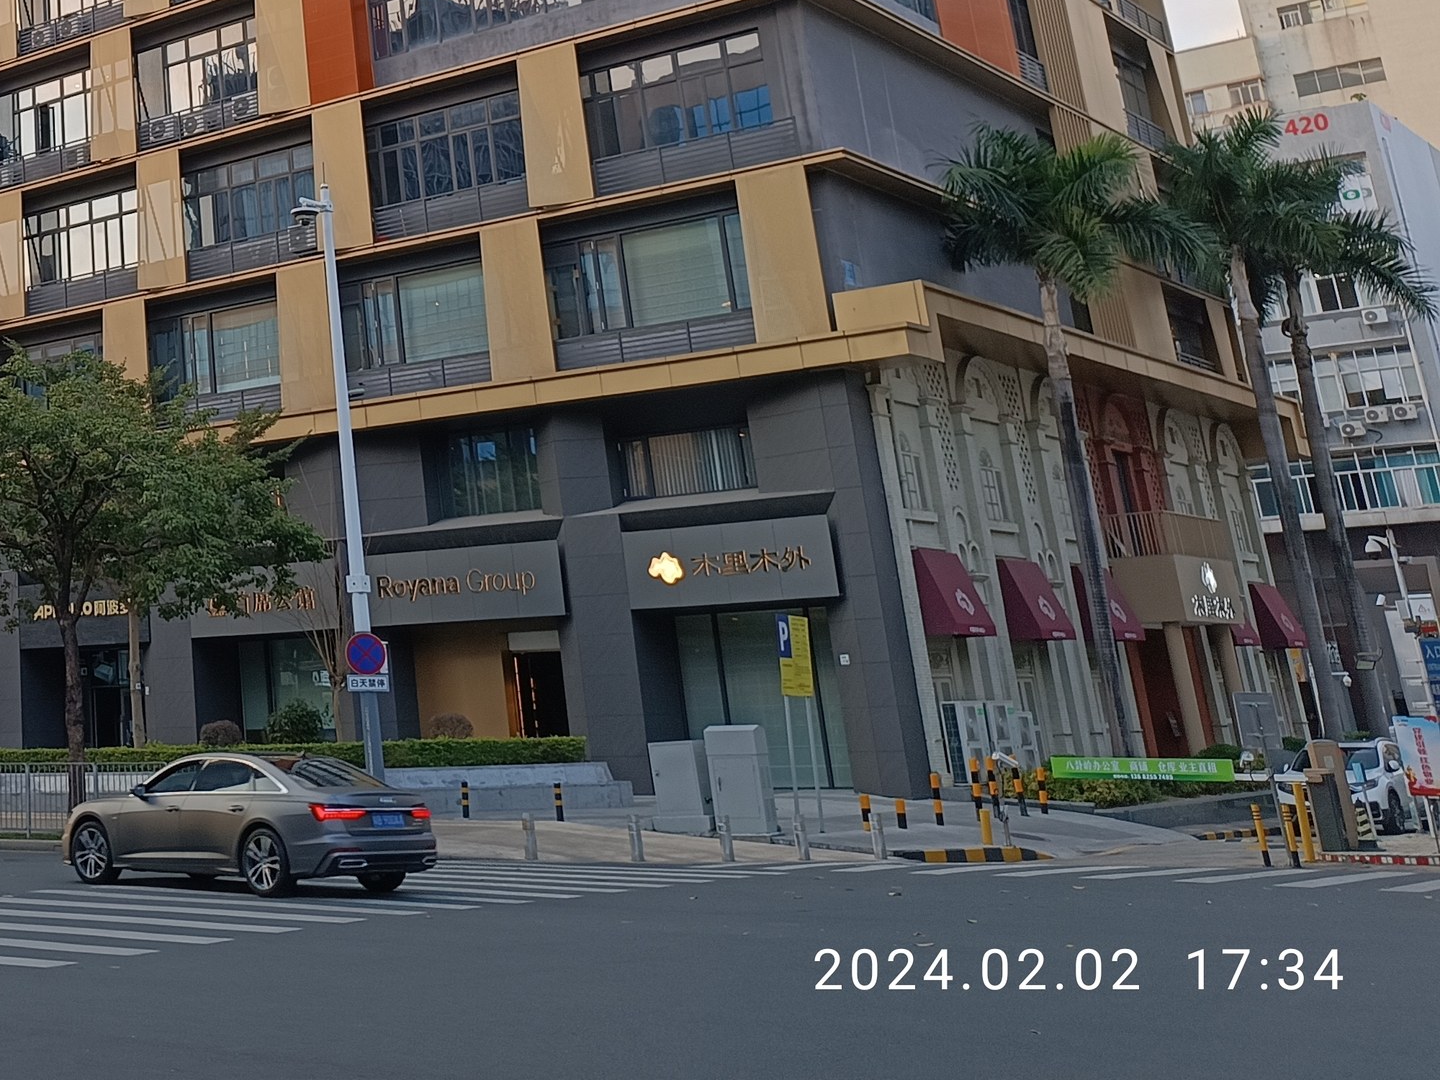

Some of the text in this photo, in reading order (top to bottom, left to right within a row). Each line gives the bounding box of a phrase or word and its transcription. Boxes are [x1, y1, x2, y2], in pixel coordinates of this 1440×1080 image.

[1285, 113, 1329, 136] 420
[376, 568, 536, 602] Royana Group
[350, 678, 386, 688] 白天禁停
